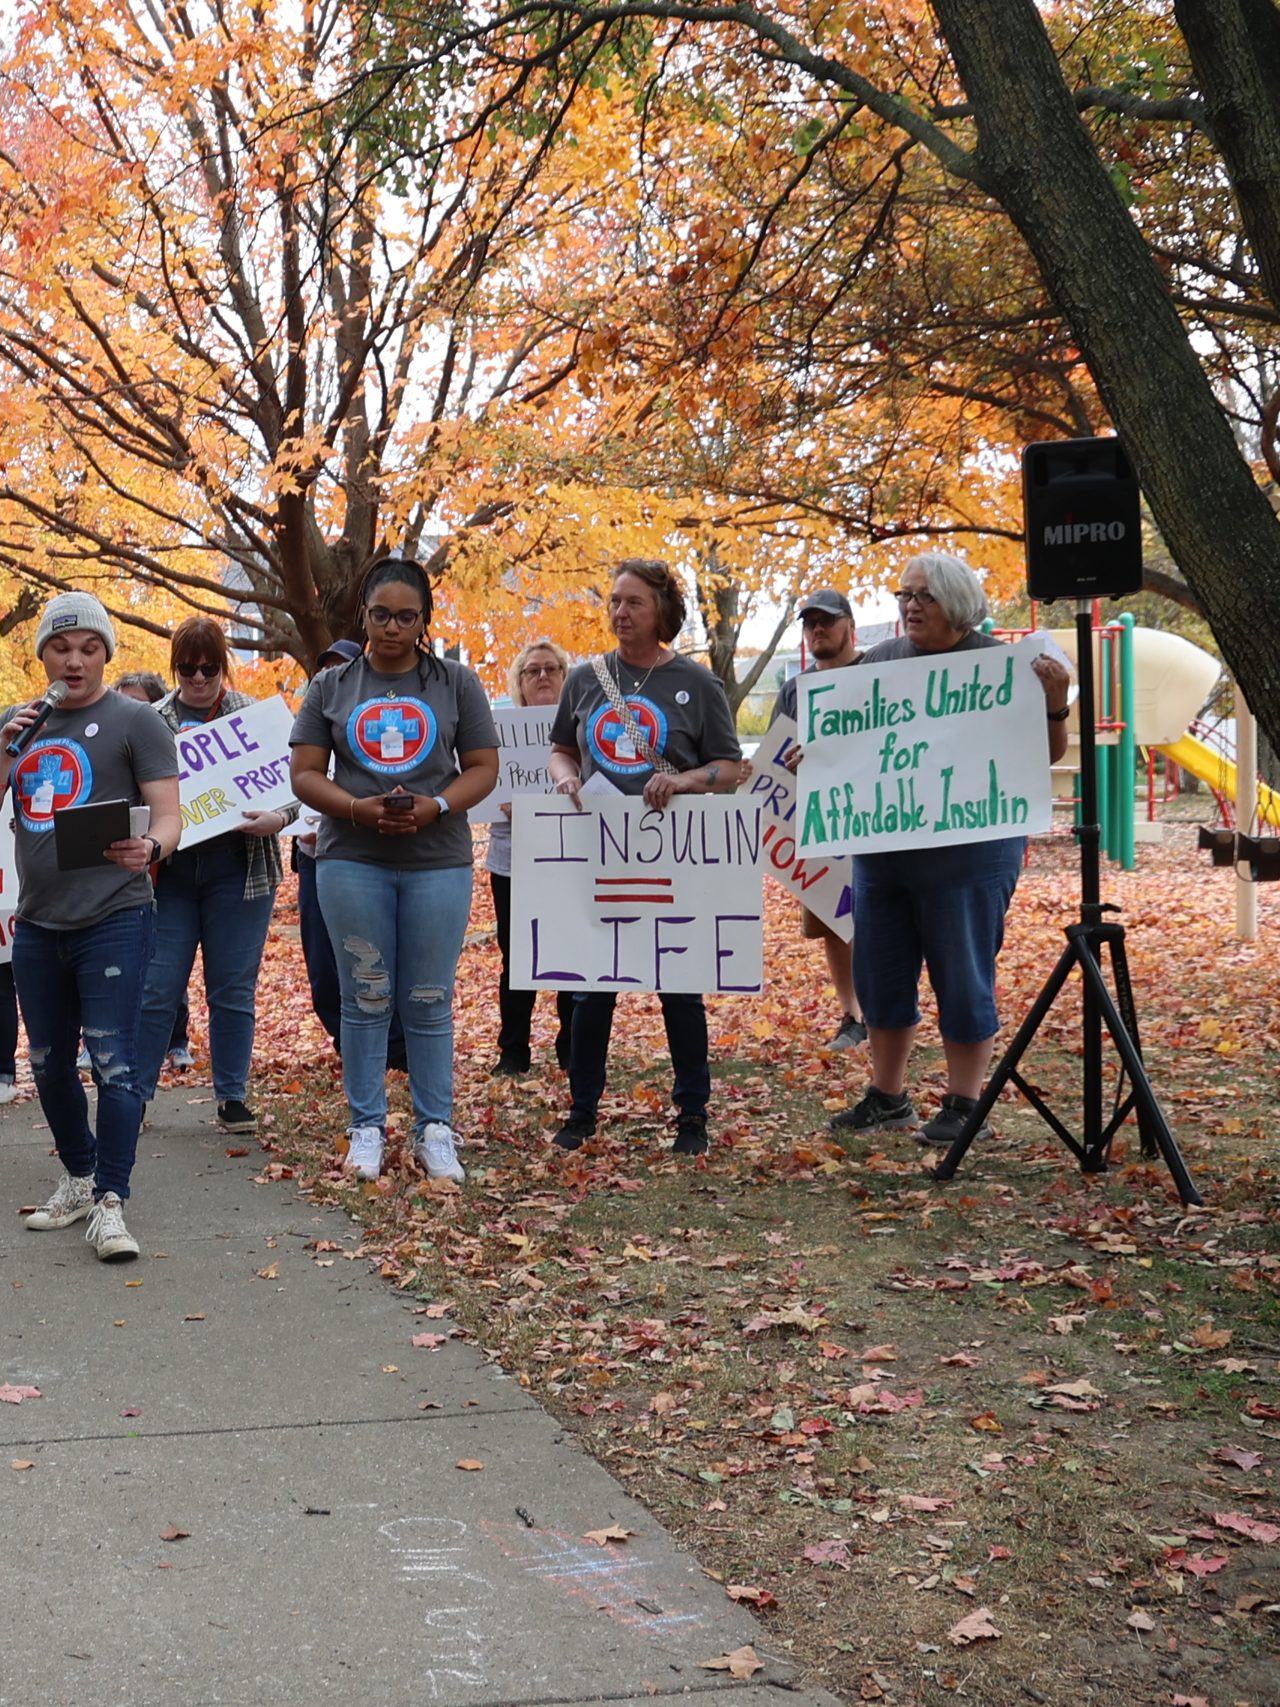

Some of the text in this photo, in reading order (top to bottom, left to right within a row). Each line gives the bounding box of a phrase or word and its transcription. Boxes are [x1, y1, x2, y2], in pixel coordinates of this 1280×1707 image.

[1044, 521, 1126, 546] MIPRO
[806, 656, 1014, 744] Families United
[506, 761, 555, 789] PROFI
[879, 731, 929, 774] for
[750, 774, 797, 822] PRI
[800, 759, 1029, 847] Affordable Insulin
[534, 808, 761, 866] INSULIN
[531, 915, 761, 992] LIFE
